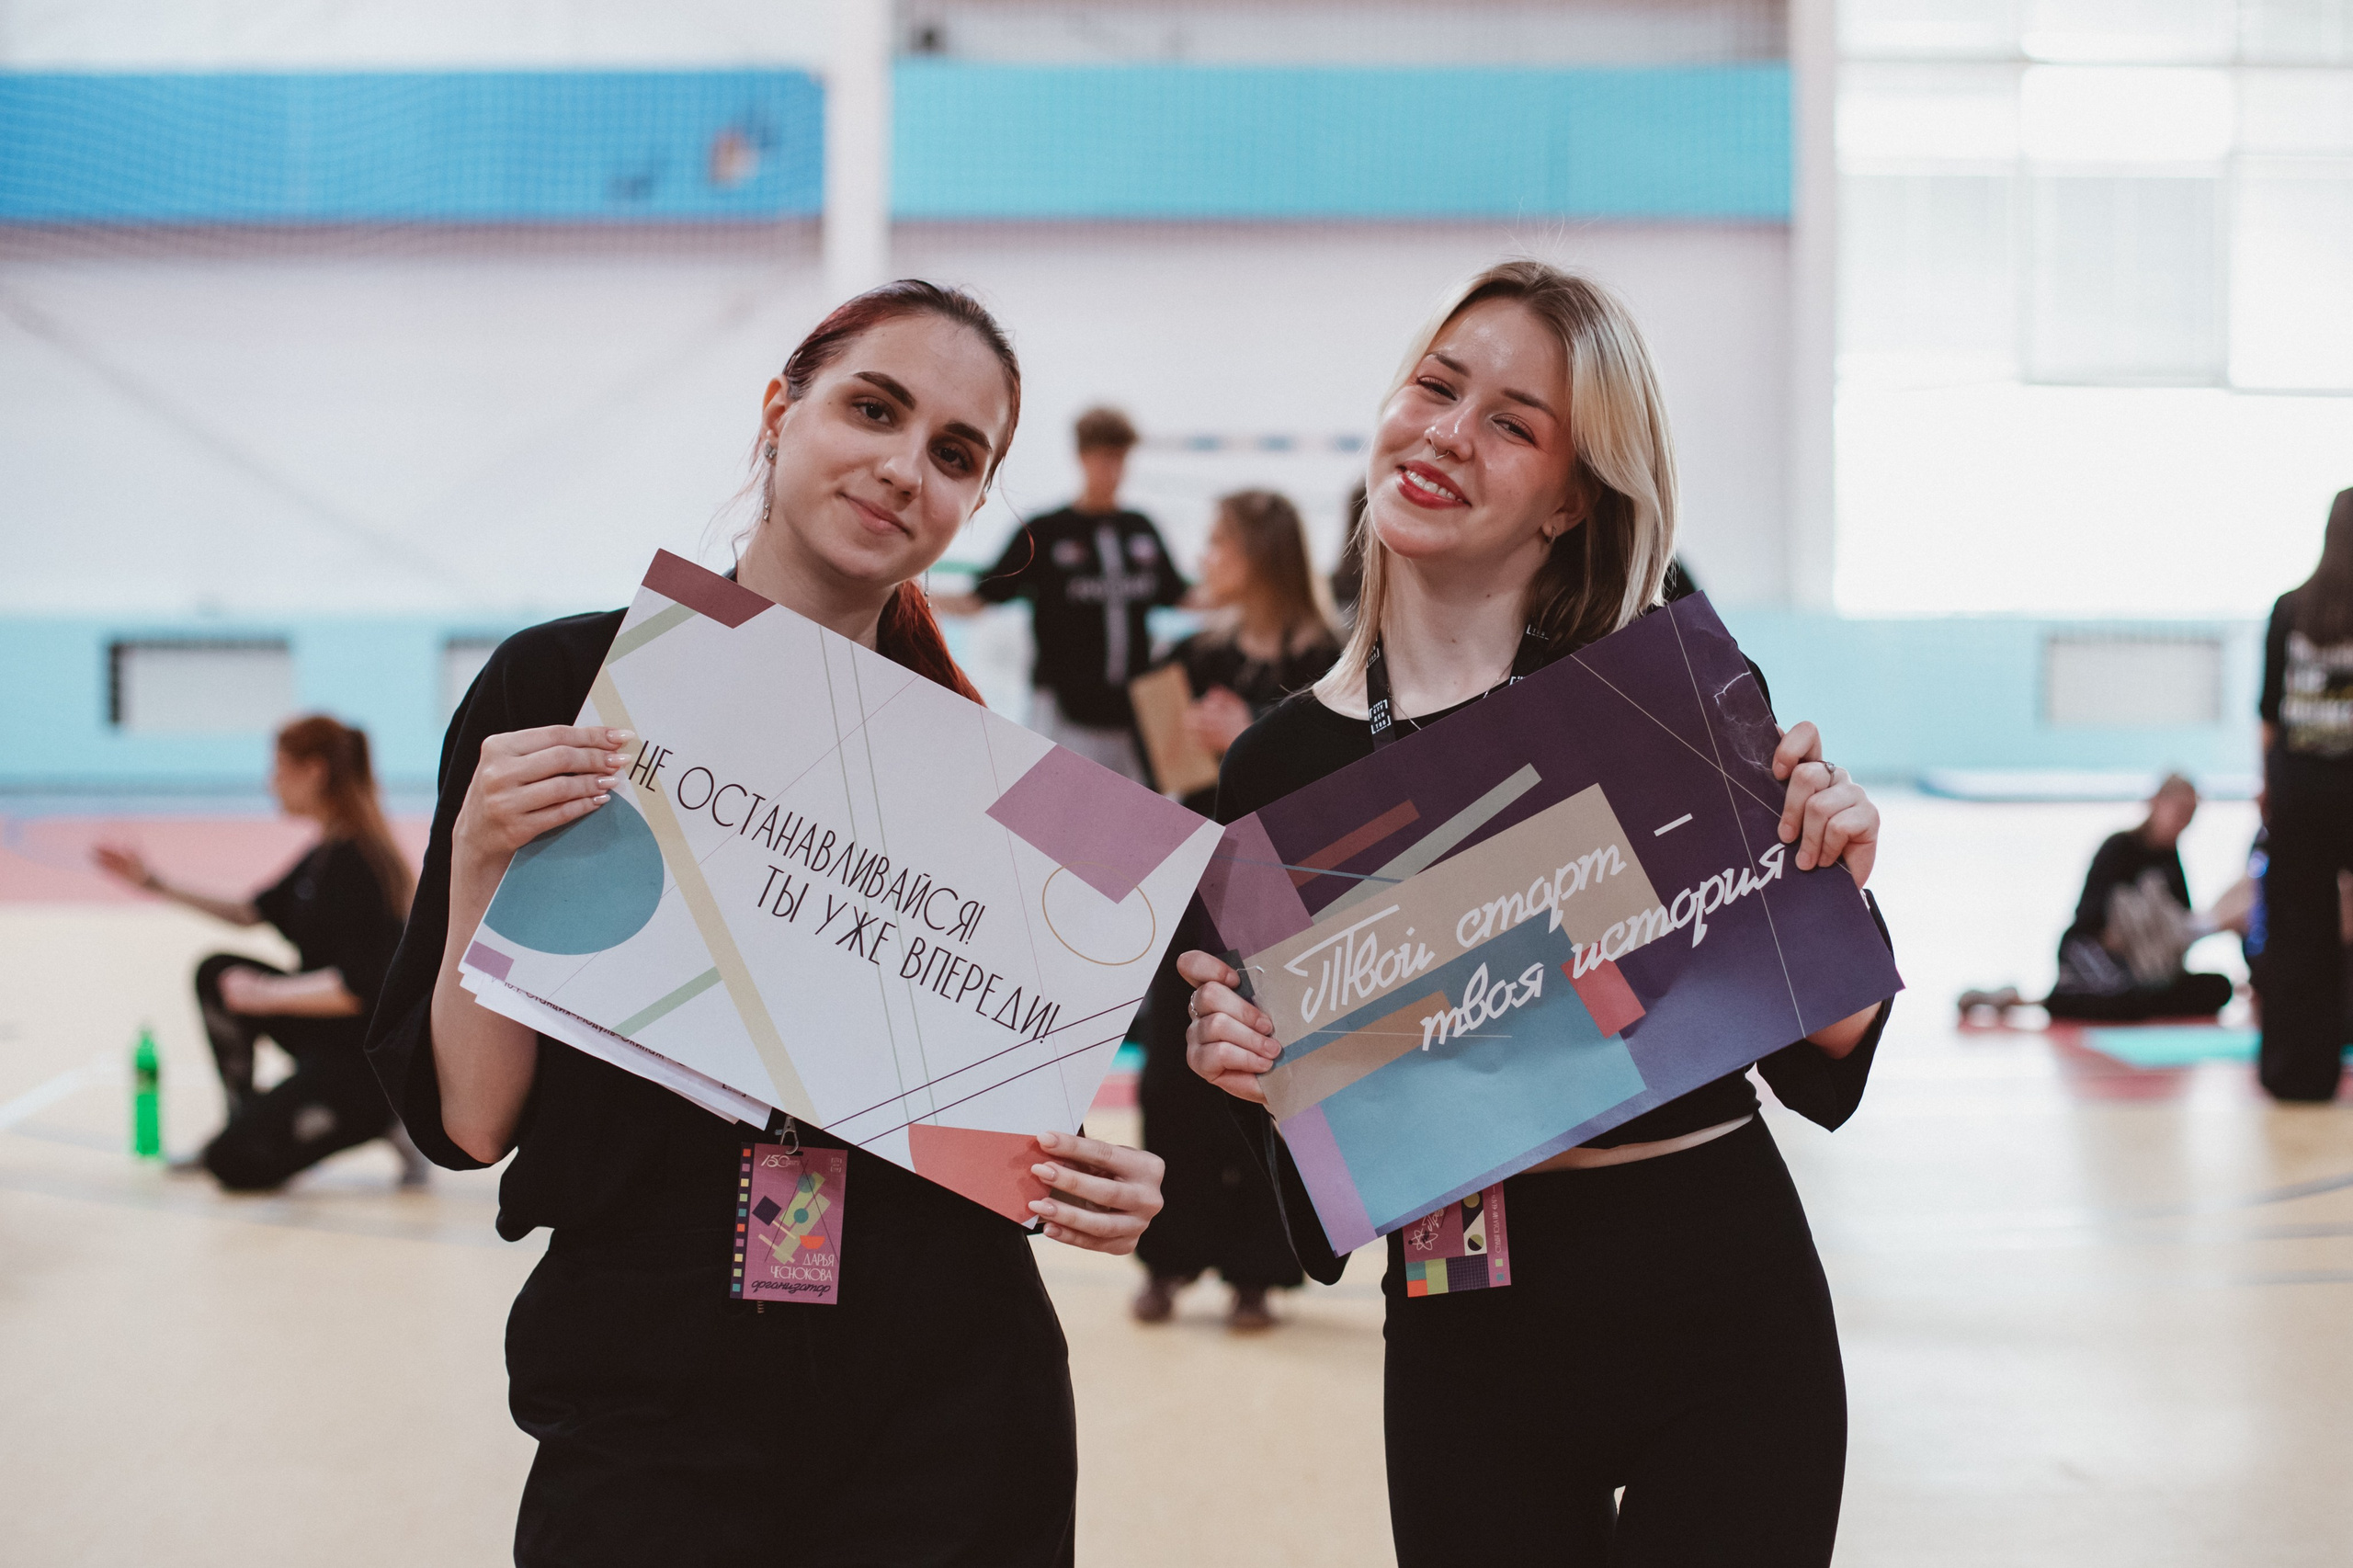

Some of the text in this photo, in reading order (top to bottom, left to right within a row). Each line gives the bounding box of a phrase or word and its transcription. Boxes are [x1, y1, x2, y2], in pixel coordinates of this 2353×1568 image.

[629, 740, 986, 946] НЕ ОСТАНАВЛИВАЙСЯ!
[756, 865, 1061, 1044] ТЫ УЖЕ ВПЕРЕДИ!
[1284, 904, 1436, 1024] Твой
[1455, 844, 1628, 948] старт
[1420, 843, 1786, 1051] твоя история
[751, 1279, 831, 1298] организатор
[770, 1265, 833, 1282] ЧЕСНОКОВА
[802, 1253, 835, 1267] ДАРЬЯ
